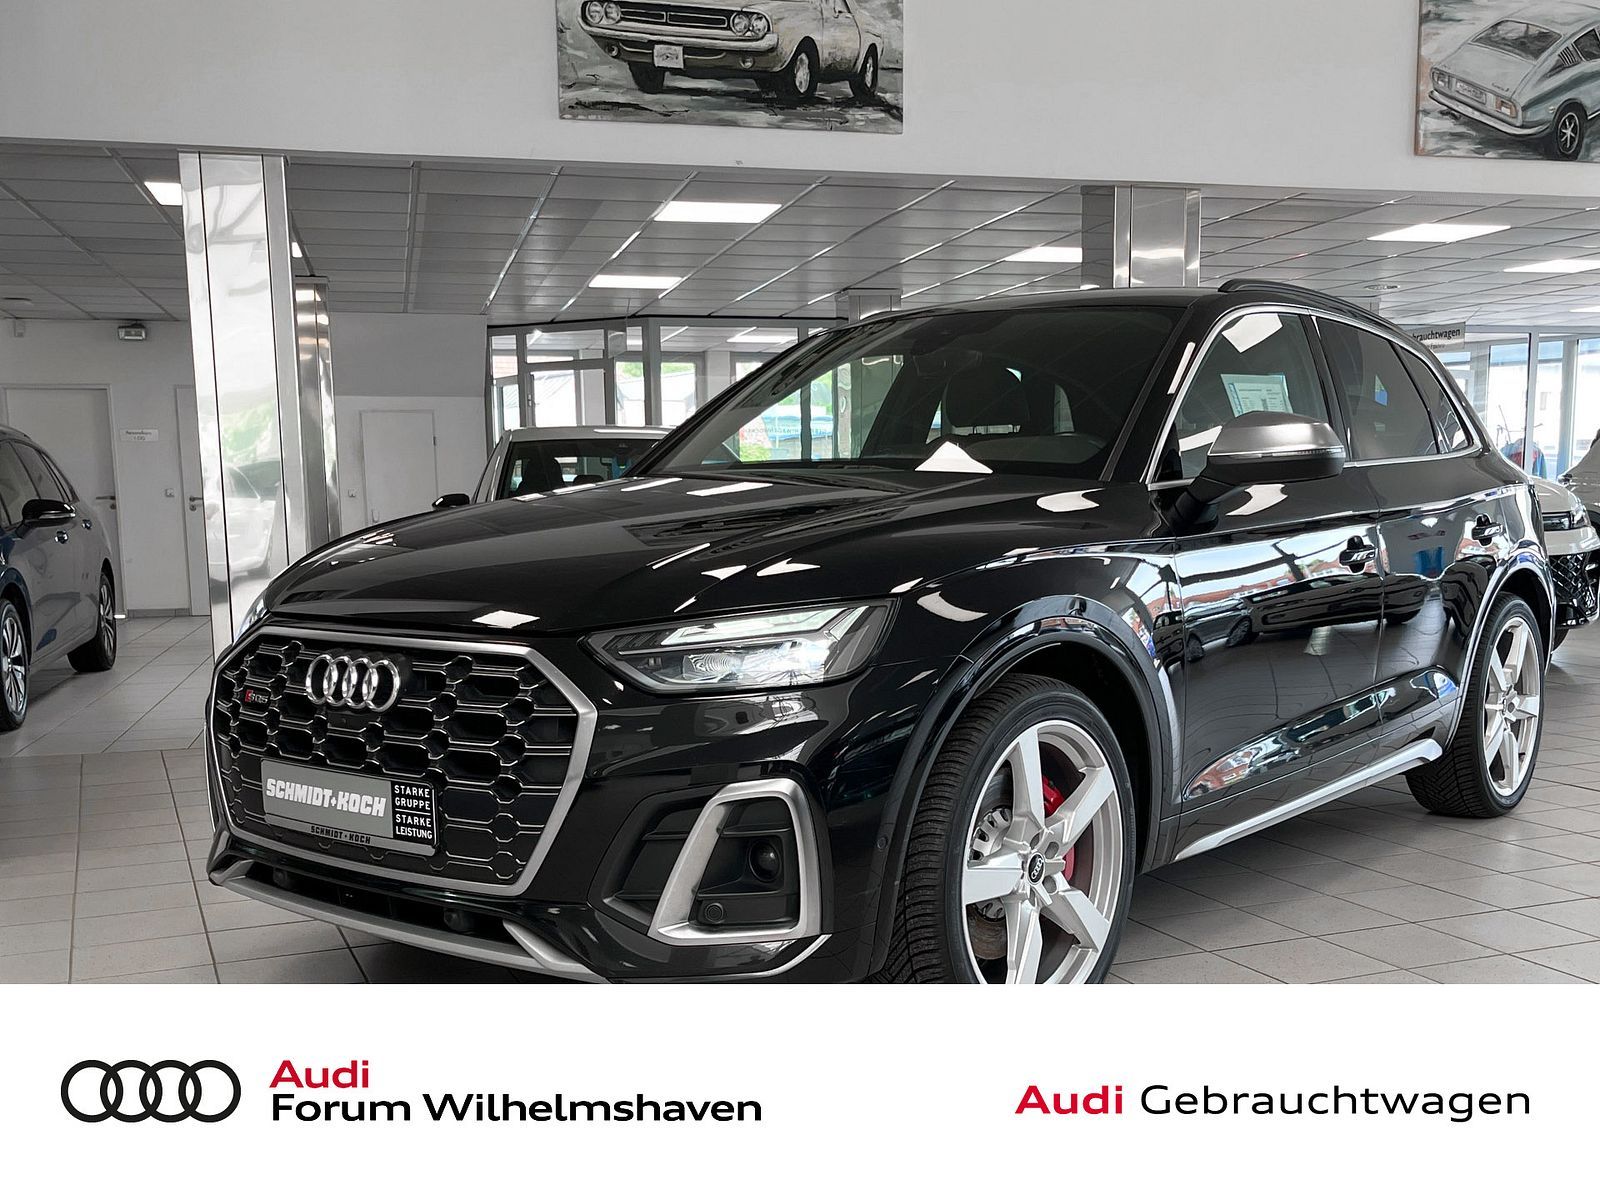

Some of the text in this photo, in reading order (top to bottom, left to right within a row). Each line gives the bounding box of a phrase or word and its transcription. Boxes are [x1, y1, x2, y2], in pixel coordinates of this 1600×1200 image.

[394, 784, 430, 798] STARKE
[395, 797, 431, 810] GRUPPE
[395, 813, 432, 828] STARKE
[310, 825, 343, 839] SCHMIDT
[349, 833, 371, 845] KOCH
[395, 825, 433, 839] LEISTUNG
